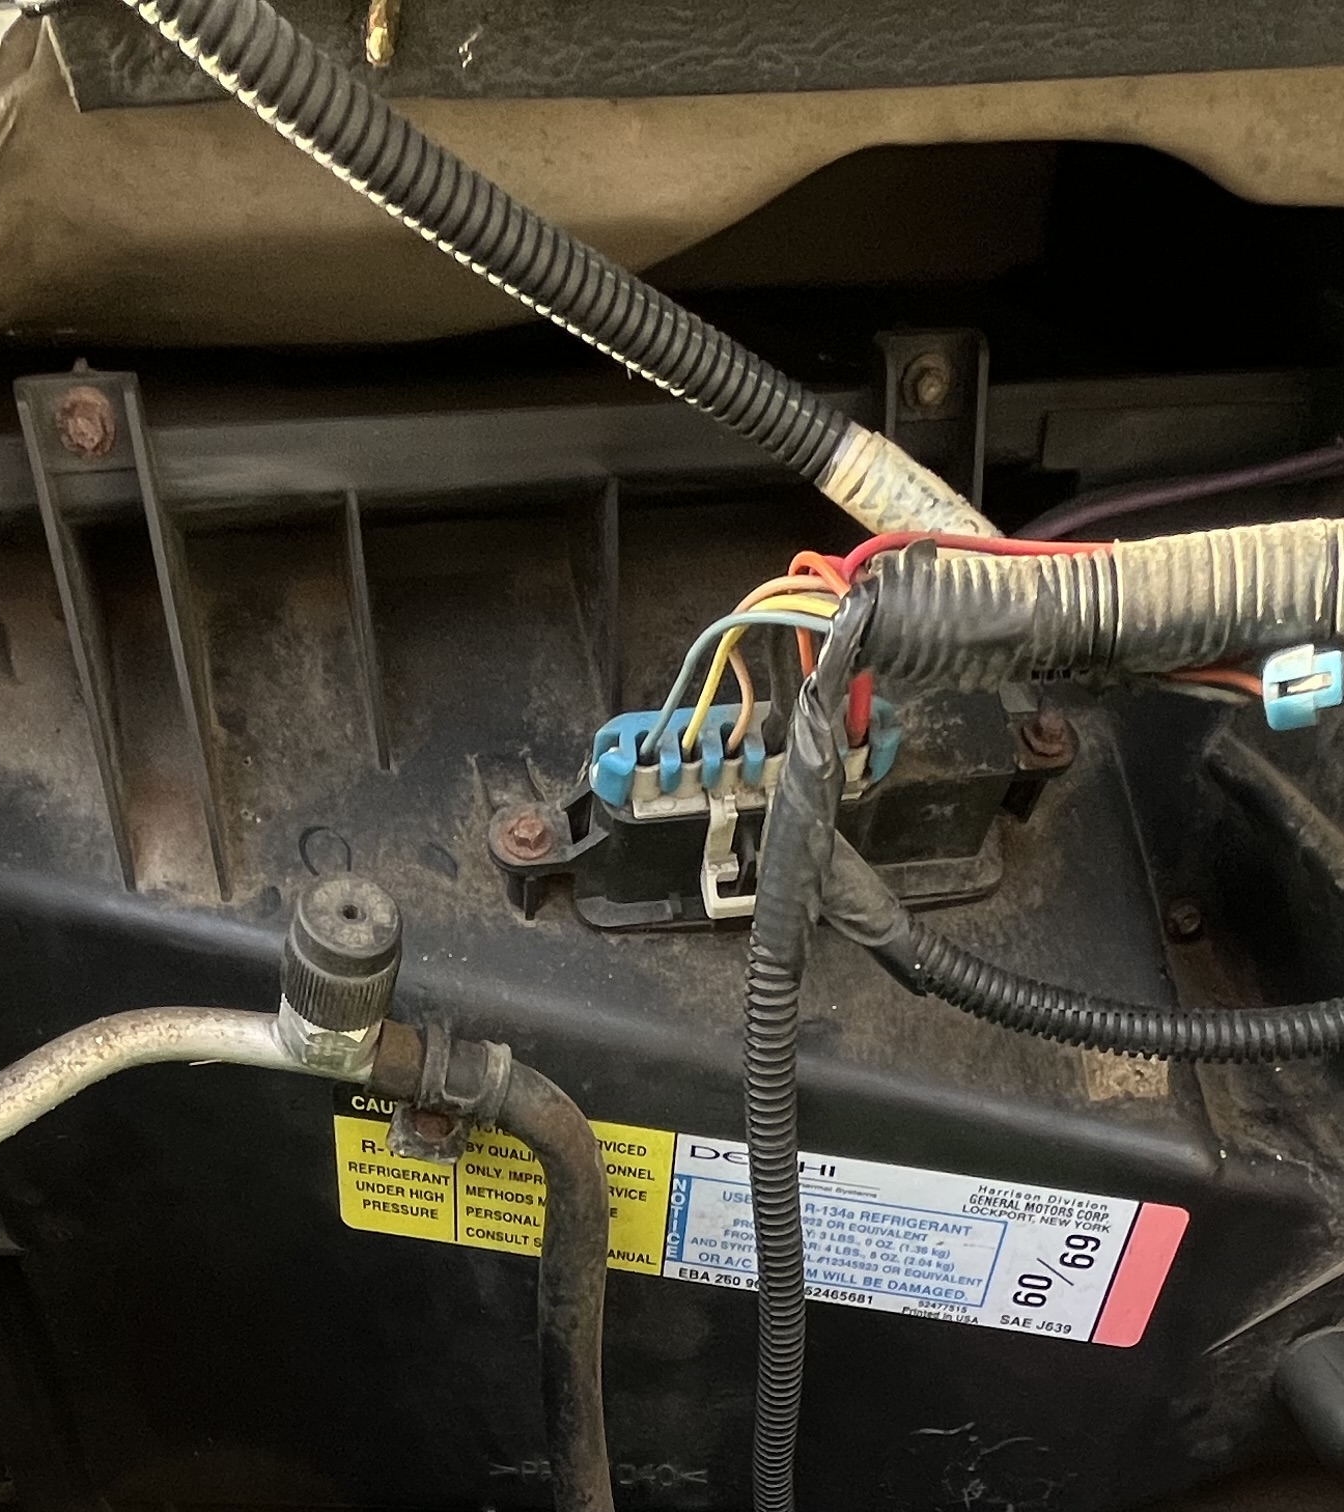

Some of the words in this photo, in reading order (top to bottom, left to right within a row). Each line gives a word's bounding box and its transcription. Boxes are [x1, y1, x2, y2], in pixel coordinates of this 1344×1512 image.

[466, 1141, 484, 1154] BY
[349, 1162, 451, 1186] REFRIGERANT
[356, 1180, 405, 1197] UNDER
[409, 1188, 444, 1203] HIGH
[466, 1186, 534, 1205] METHODS
[978, 1185, 1041, 1201] Harrison
[1048, 1195, 1108, 1211] Division
[363, 1199, 439, 1220] PRESSURE
[466, 1206, 541, 1227] PERSONAL
[969, 1194, 1020, 1211] GENERAL
[1025, 1202, 1073, 1218] MOTORS
[666, 1178, 687, 1258] NOTICE
[805, 1204, 855, 1219] R-134a
[860, 1211, 973, 1236] REFRIGERANT
[962, 1204, 1036, 1224] LOCKPORT,
[1039, 1216, 1071, 1228] NEW
[1075, 1221, 1111, 1233] YORK
[466, 1227, 529, 1245] CONSULT
[690, 1237, 717, 1248] AND
[849, 1224, 928, 1242] EQUIVALENT
[679, 1267, 710, 1282] EBA
[698, 1252, 720, 1265] OR
[724, 1256, 752, 1269] A/C
[823, 1270, 856, 1285] WILL
[863, 1276, 883, 1289] BE
[887, 1280, 968, 1301] DAMAGED.
[906, 1268, 983, 1288] EQUIVALENT
[902, 1306, 941, 1320] Printed
[956, 1315, 979, 1325] USA
[1000, 1314, 1033, 1328] SAE
[1036, 1321, 1072, 1335] J639
